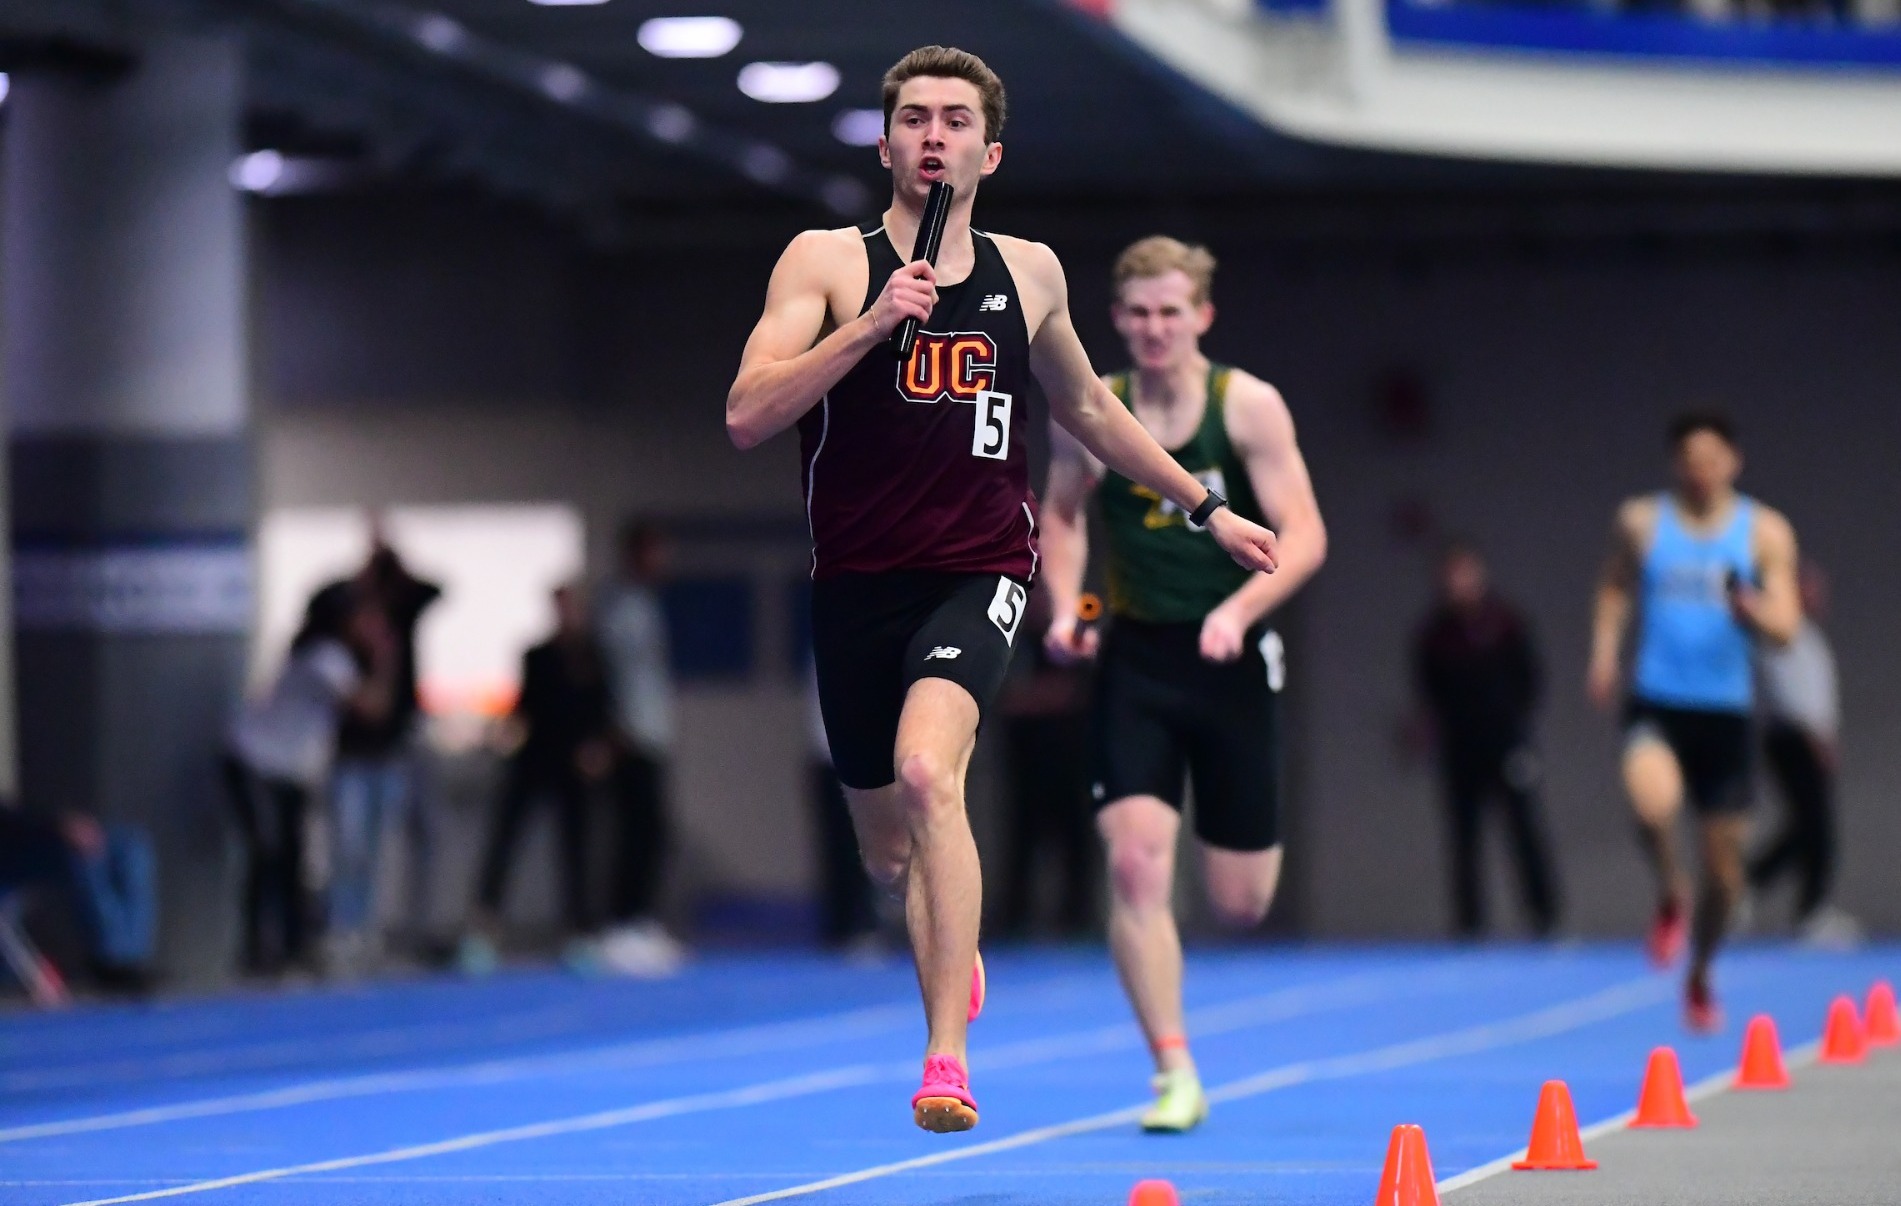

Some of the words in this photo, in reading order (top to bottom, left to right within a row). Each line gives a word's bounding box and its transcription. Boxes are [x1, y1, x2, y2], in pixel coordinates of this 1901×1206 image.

[979, 294, 1008, 312] NB
[898, 332, 996, 402] UC
[983, 396, 1006, 456] 5
[996, 582, 1024, 633] 5
